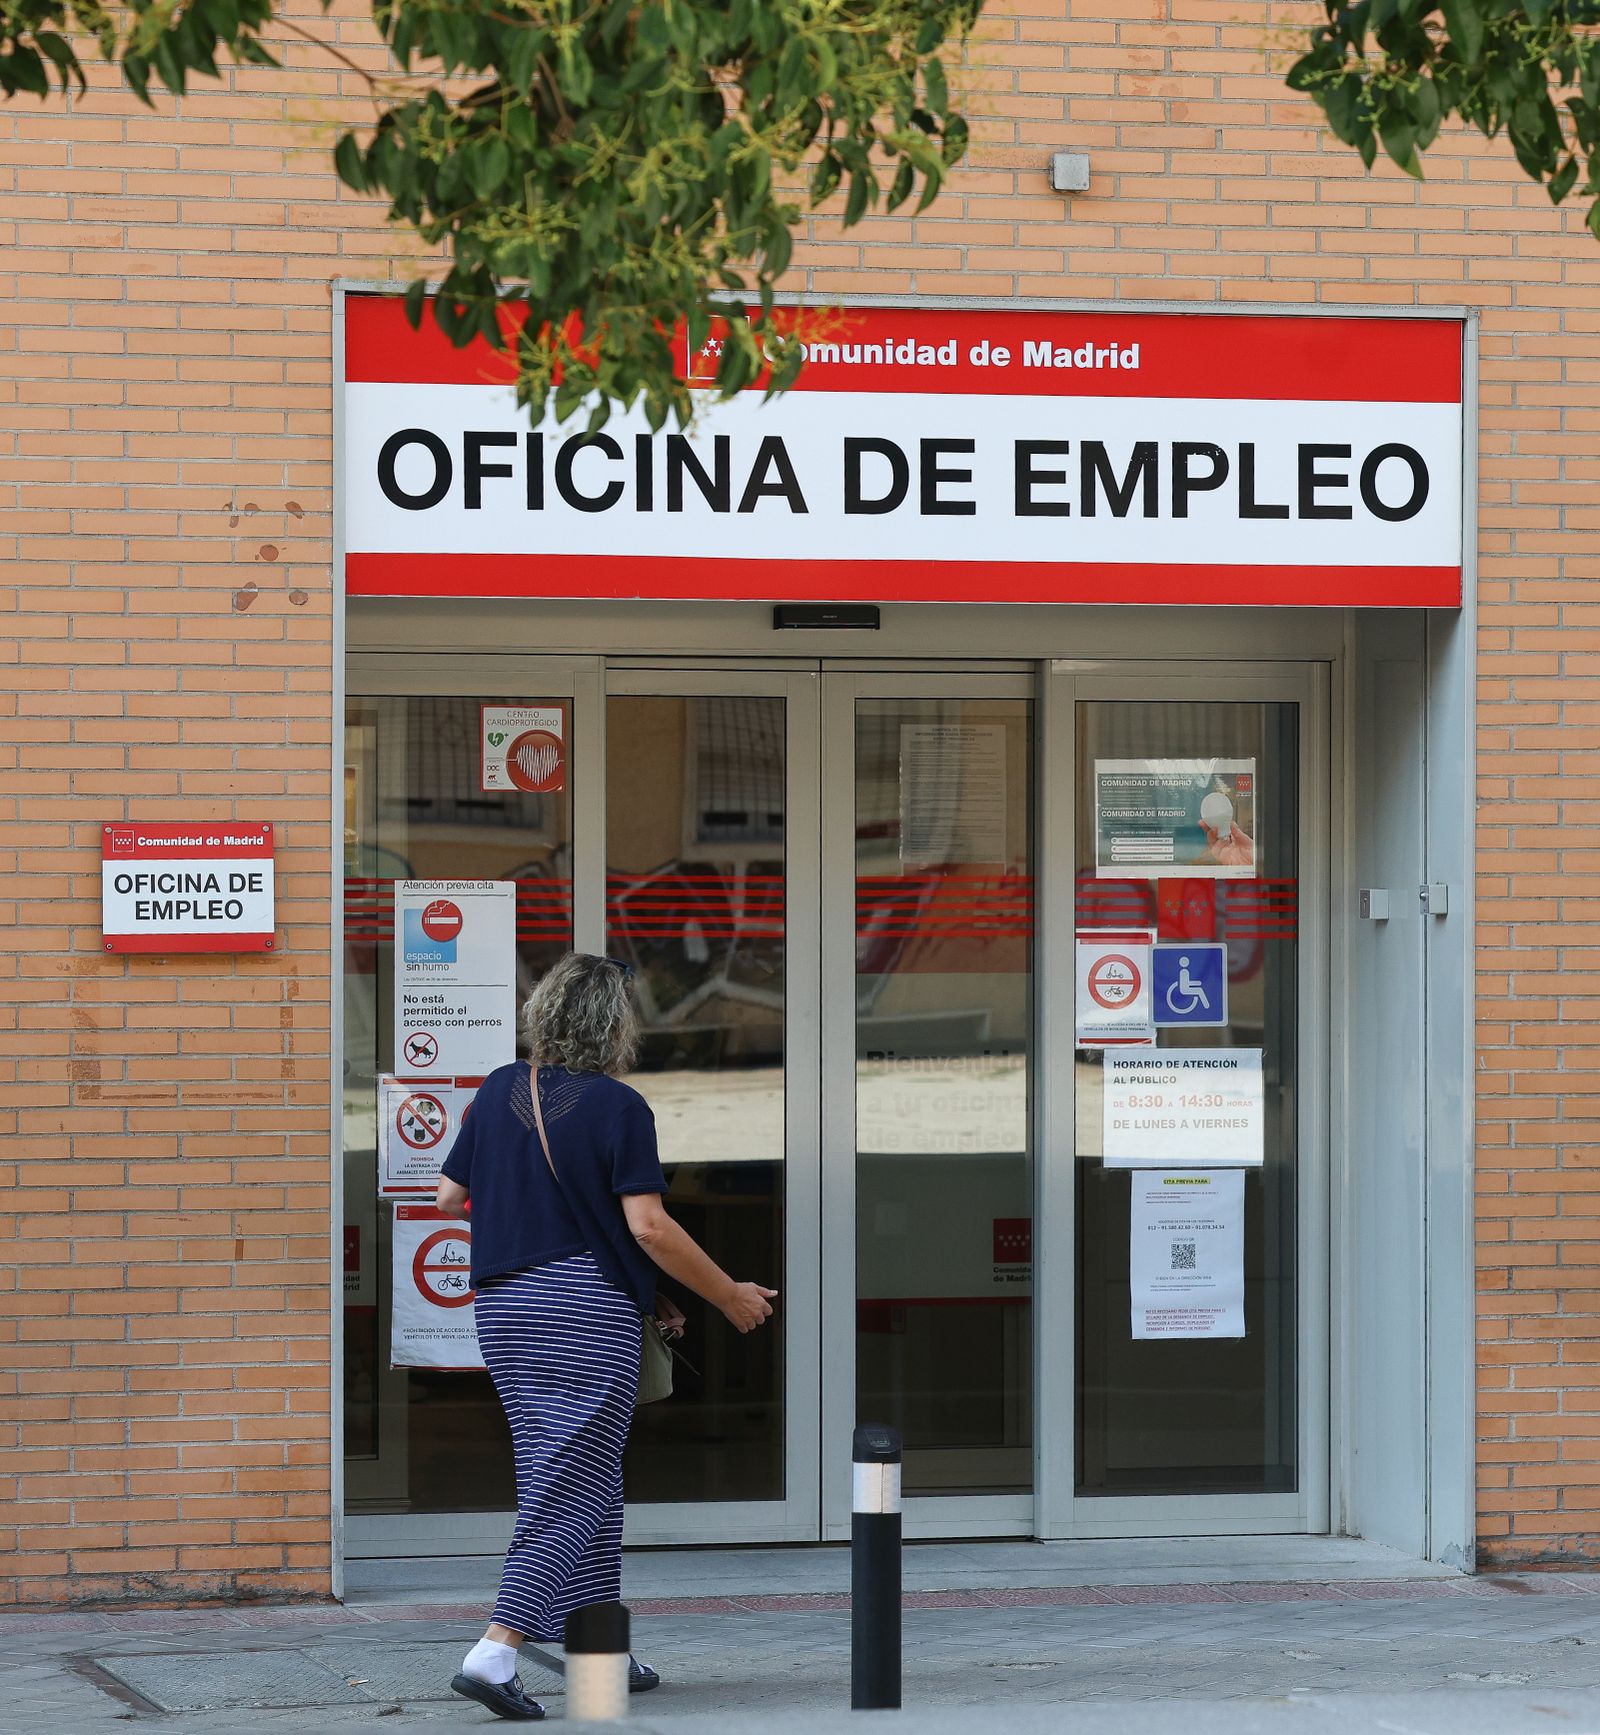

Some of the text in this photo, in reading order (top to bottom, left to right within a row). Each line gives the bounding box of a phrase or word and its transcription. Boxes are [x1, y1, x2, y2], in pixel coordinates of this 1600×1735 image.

[969, 340, 1011, 367] de
[1023, 341, 1140, 369] Madrid
[377, 428, 1430, 522] OFICINA DE EMPLEO
[506, 710, 540, 718] CENTRO
[486, 718, 559, 727] CARDIOPROTEGIDO
[1101, 779, 1192, 787] COMUNIDAD DE MADRID
[1101, 810, 1145, 818] COMUNIDAD
[1146, 810, 1156, 818] DE
[137, 836, 264, 847] Comunidad de Madrid
[114, 873, 263, 894] OFICINA DE
[402, 880, 494, 893] Atención previa cita
[135, 899, 243, 920] EMPLEO
[406, 950, 442, 962] espacio
[406, 962, 449, 971] sin humo
[403, 994, 444, 1004] No está
[403, 1006, 467, 1017] permitido el
[403, 1019, 503, 1028] acceso con perros
[1113, 1058, 1238, 1069] HORARIO DE ATENCIÓN
[1113, 1076, 1127, 1084] AL
[1128, 1095, 1163, 1108] 8:30
[1179, 1094, 1223, 1108] 14:30
[1113, 1118, 1249, 1129] DE LUNES A VIERNES
